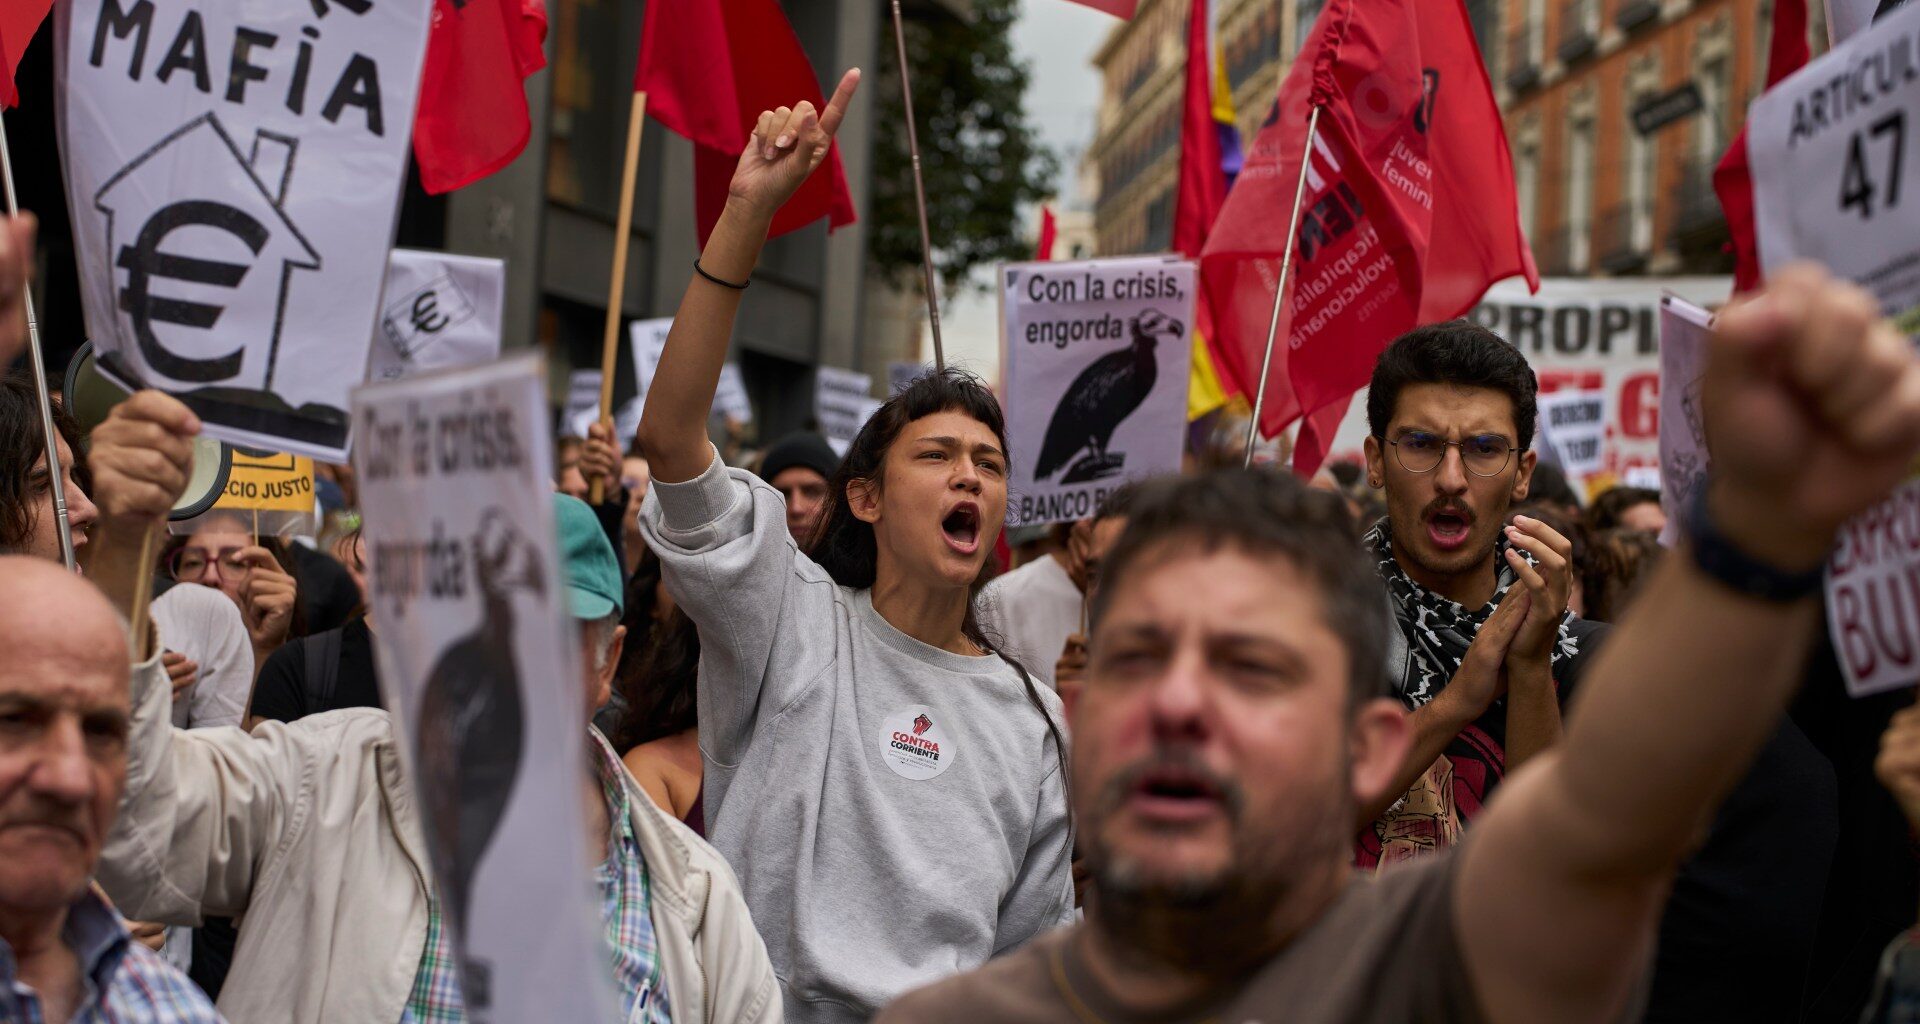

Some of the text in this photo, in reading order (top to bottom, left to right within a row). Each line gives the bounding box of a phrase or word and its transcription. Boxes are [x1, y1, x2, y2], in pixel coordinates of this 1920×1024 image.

[1838, 108, 1907, 221] 47
[1028, 271, 1184, 302] Con la crisis,
[1026, 312, 1123, 349] engorda
[262, 476, 310, 499] JUSTO
[1021, 490, 1089, 522] BANCO
[890, 740, 940, 761] CORRIENTE
[892, 731, 940, 753] CONTRA
